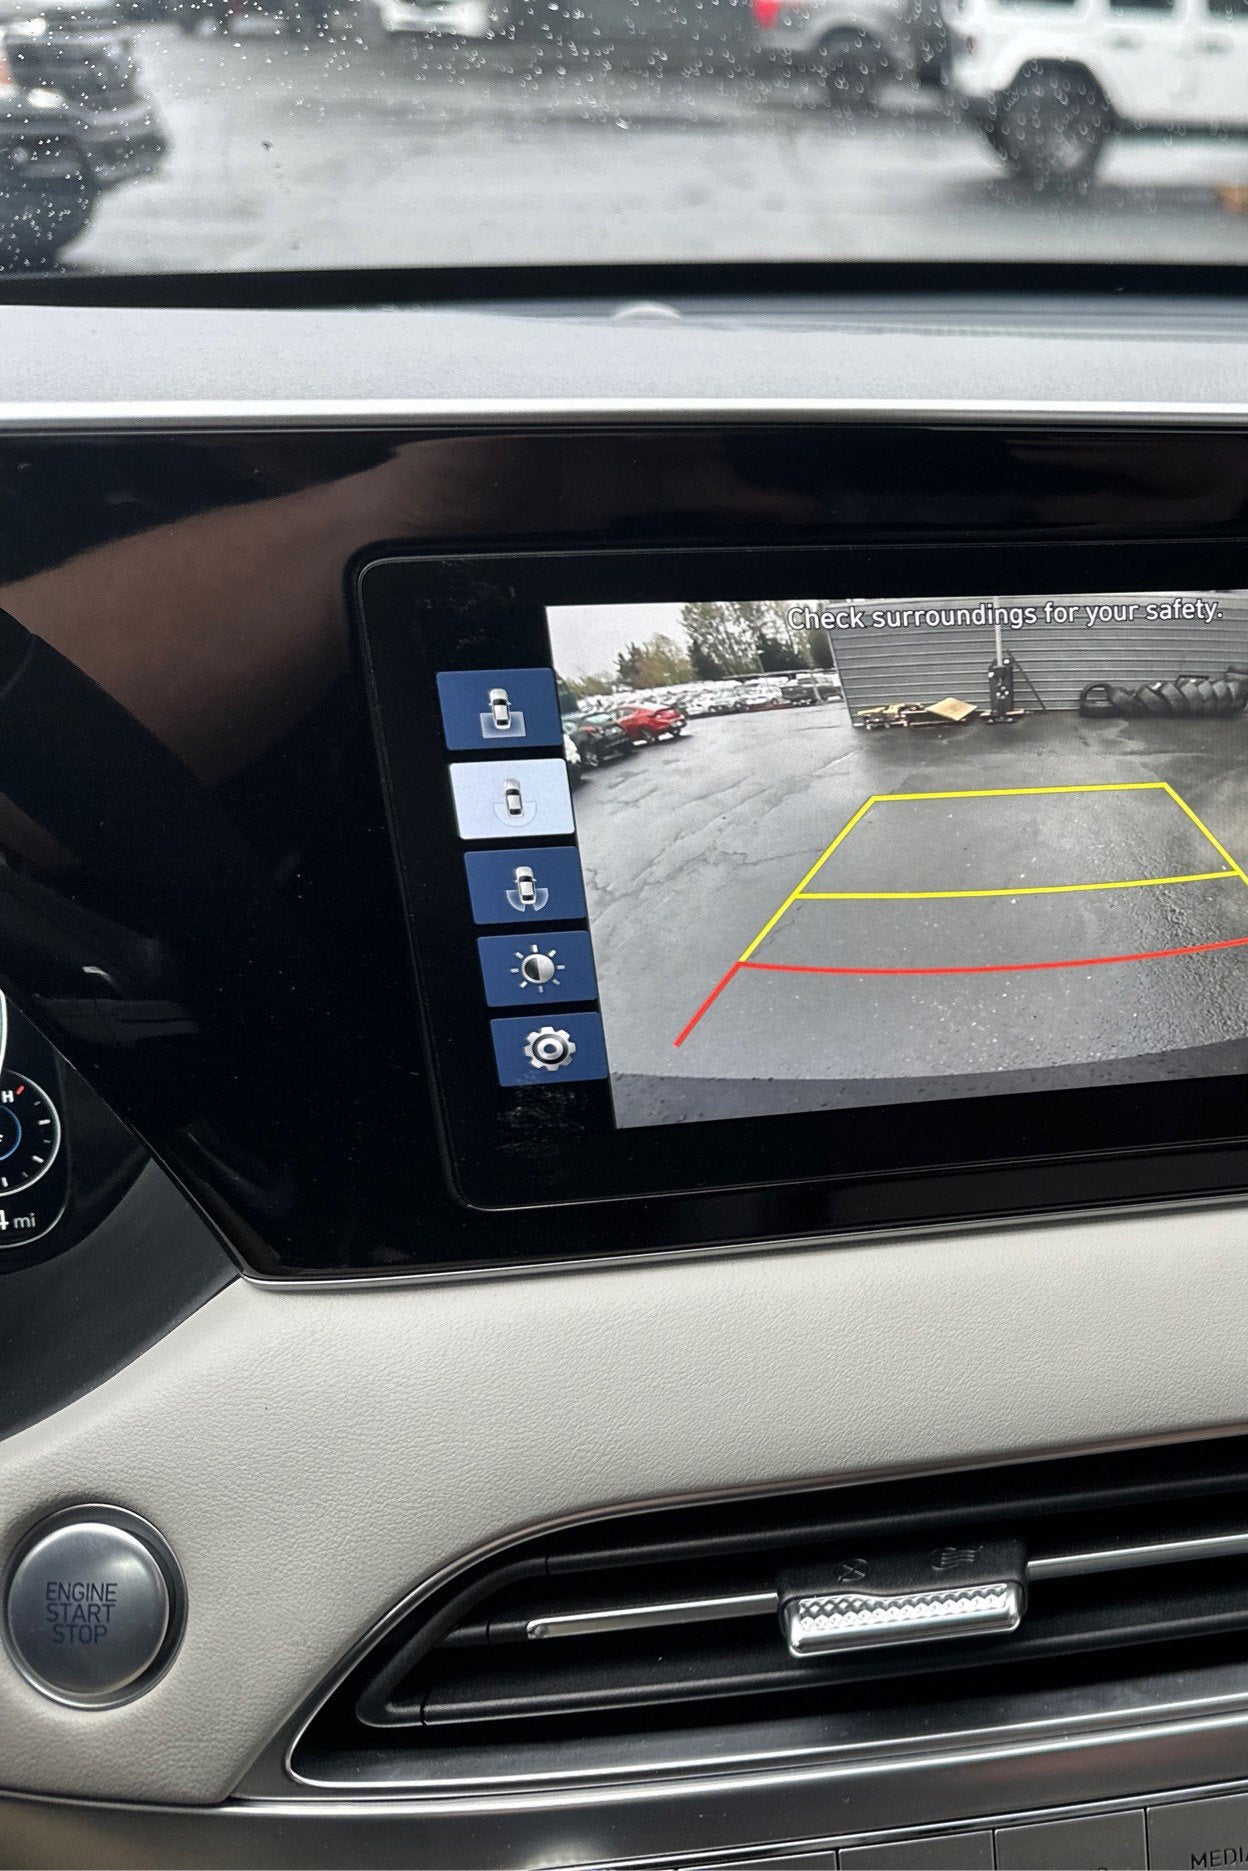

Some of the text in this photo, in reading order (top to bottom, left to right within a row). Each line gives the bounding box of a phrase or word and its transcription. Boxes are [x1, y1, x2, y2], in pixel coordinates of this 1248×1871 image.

[788, 597, 1224, 630] Check surroundings for your safety.
[1, 1090, 14, 1103] H
[13, 1213, 36, 1229] mi
[46, 1582, 118, 1603] ENGINE
[46, 1603, 115, 1623] START
[53, 1624, 108, 1644] STOP
